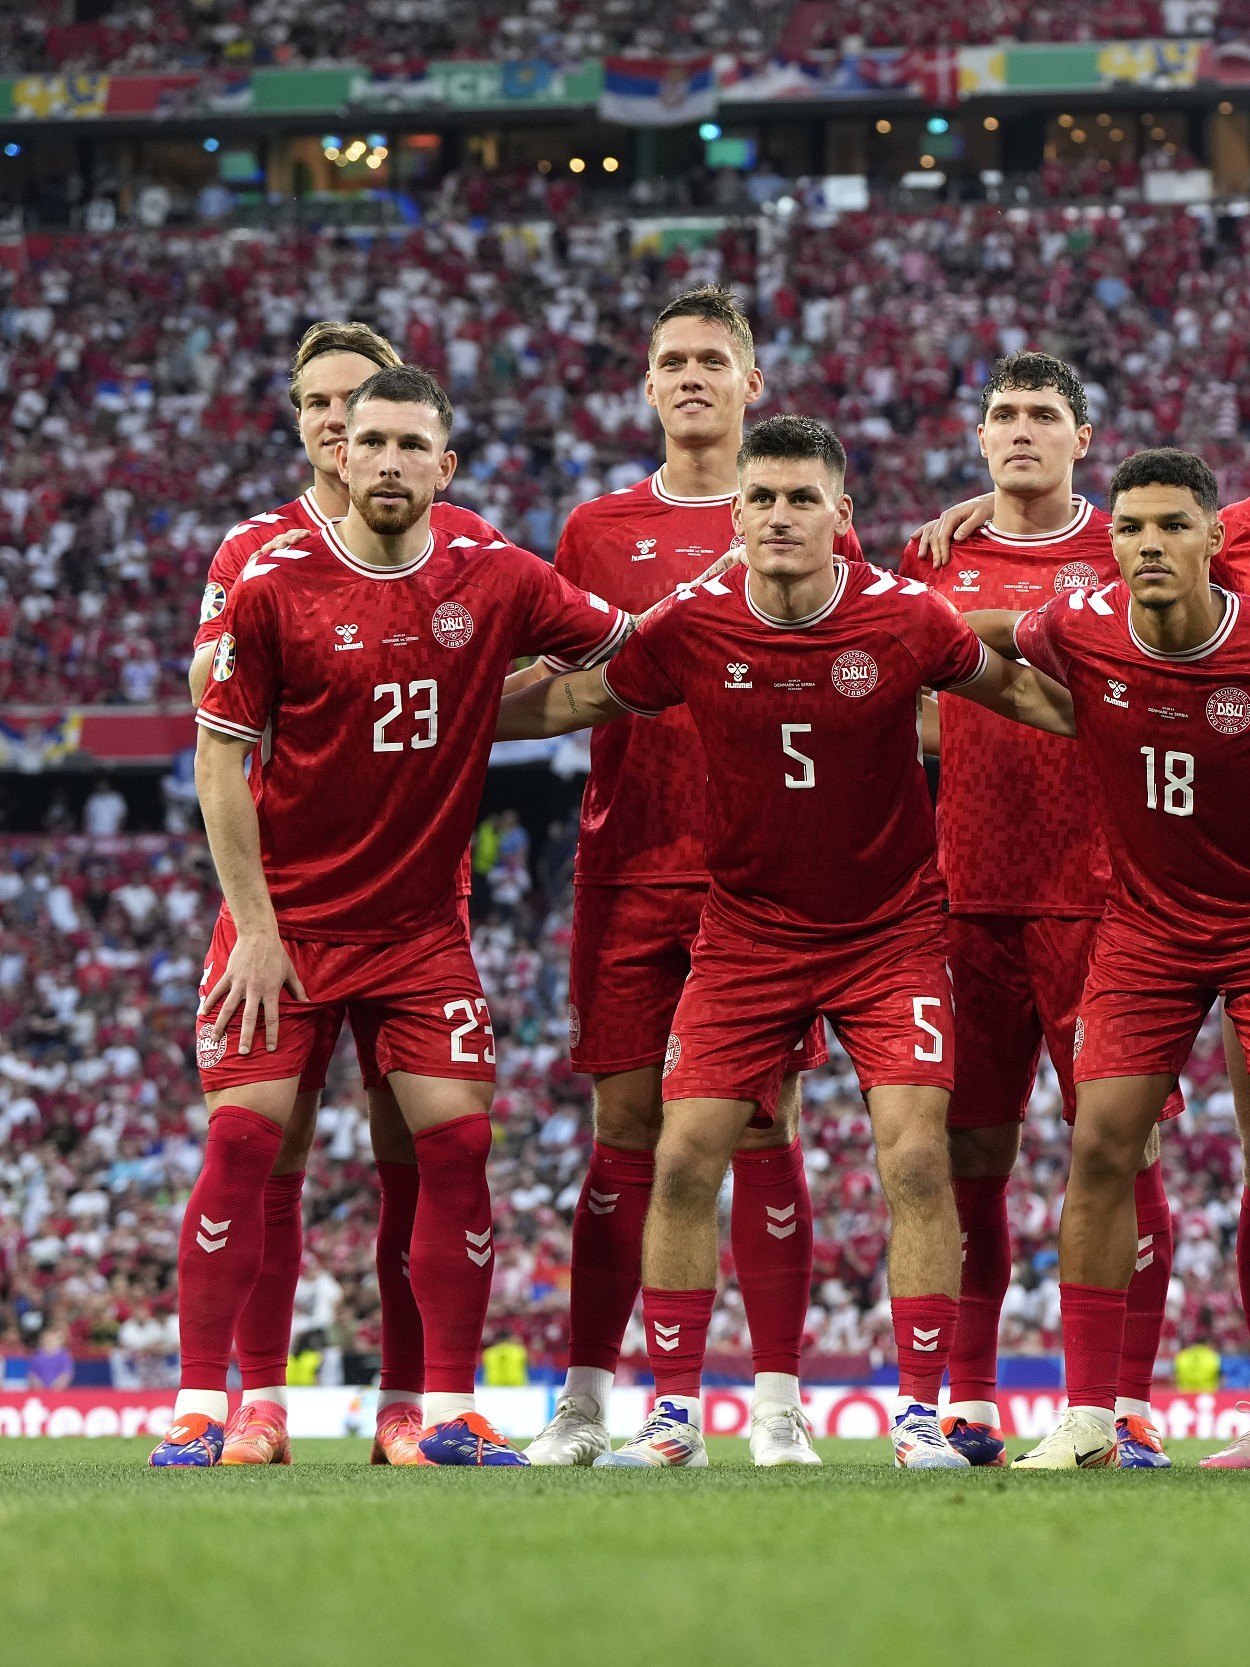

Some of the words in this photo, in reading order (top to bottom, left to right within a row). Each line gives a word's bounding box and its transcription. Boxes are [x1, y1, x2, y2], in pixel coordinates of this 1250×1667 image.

[1063, 576, 1089, 587] DBU
[440, 617, 464, 632] DBU
[334, 641, 363, 651] hummel
[842, 665, 868, 680] DBU
[1104, 694, 1128, 708] hummel
[373, 679, 438, 752] 23
[1216, 703, 1243, 717] DBU
[781, 724, 815, 788] 5
[1141, 746, 1194, 816] 18
[444, 998, 496, 1064] 23
[913, 996, 943, 1063] 5
